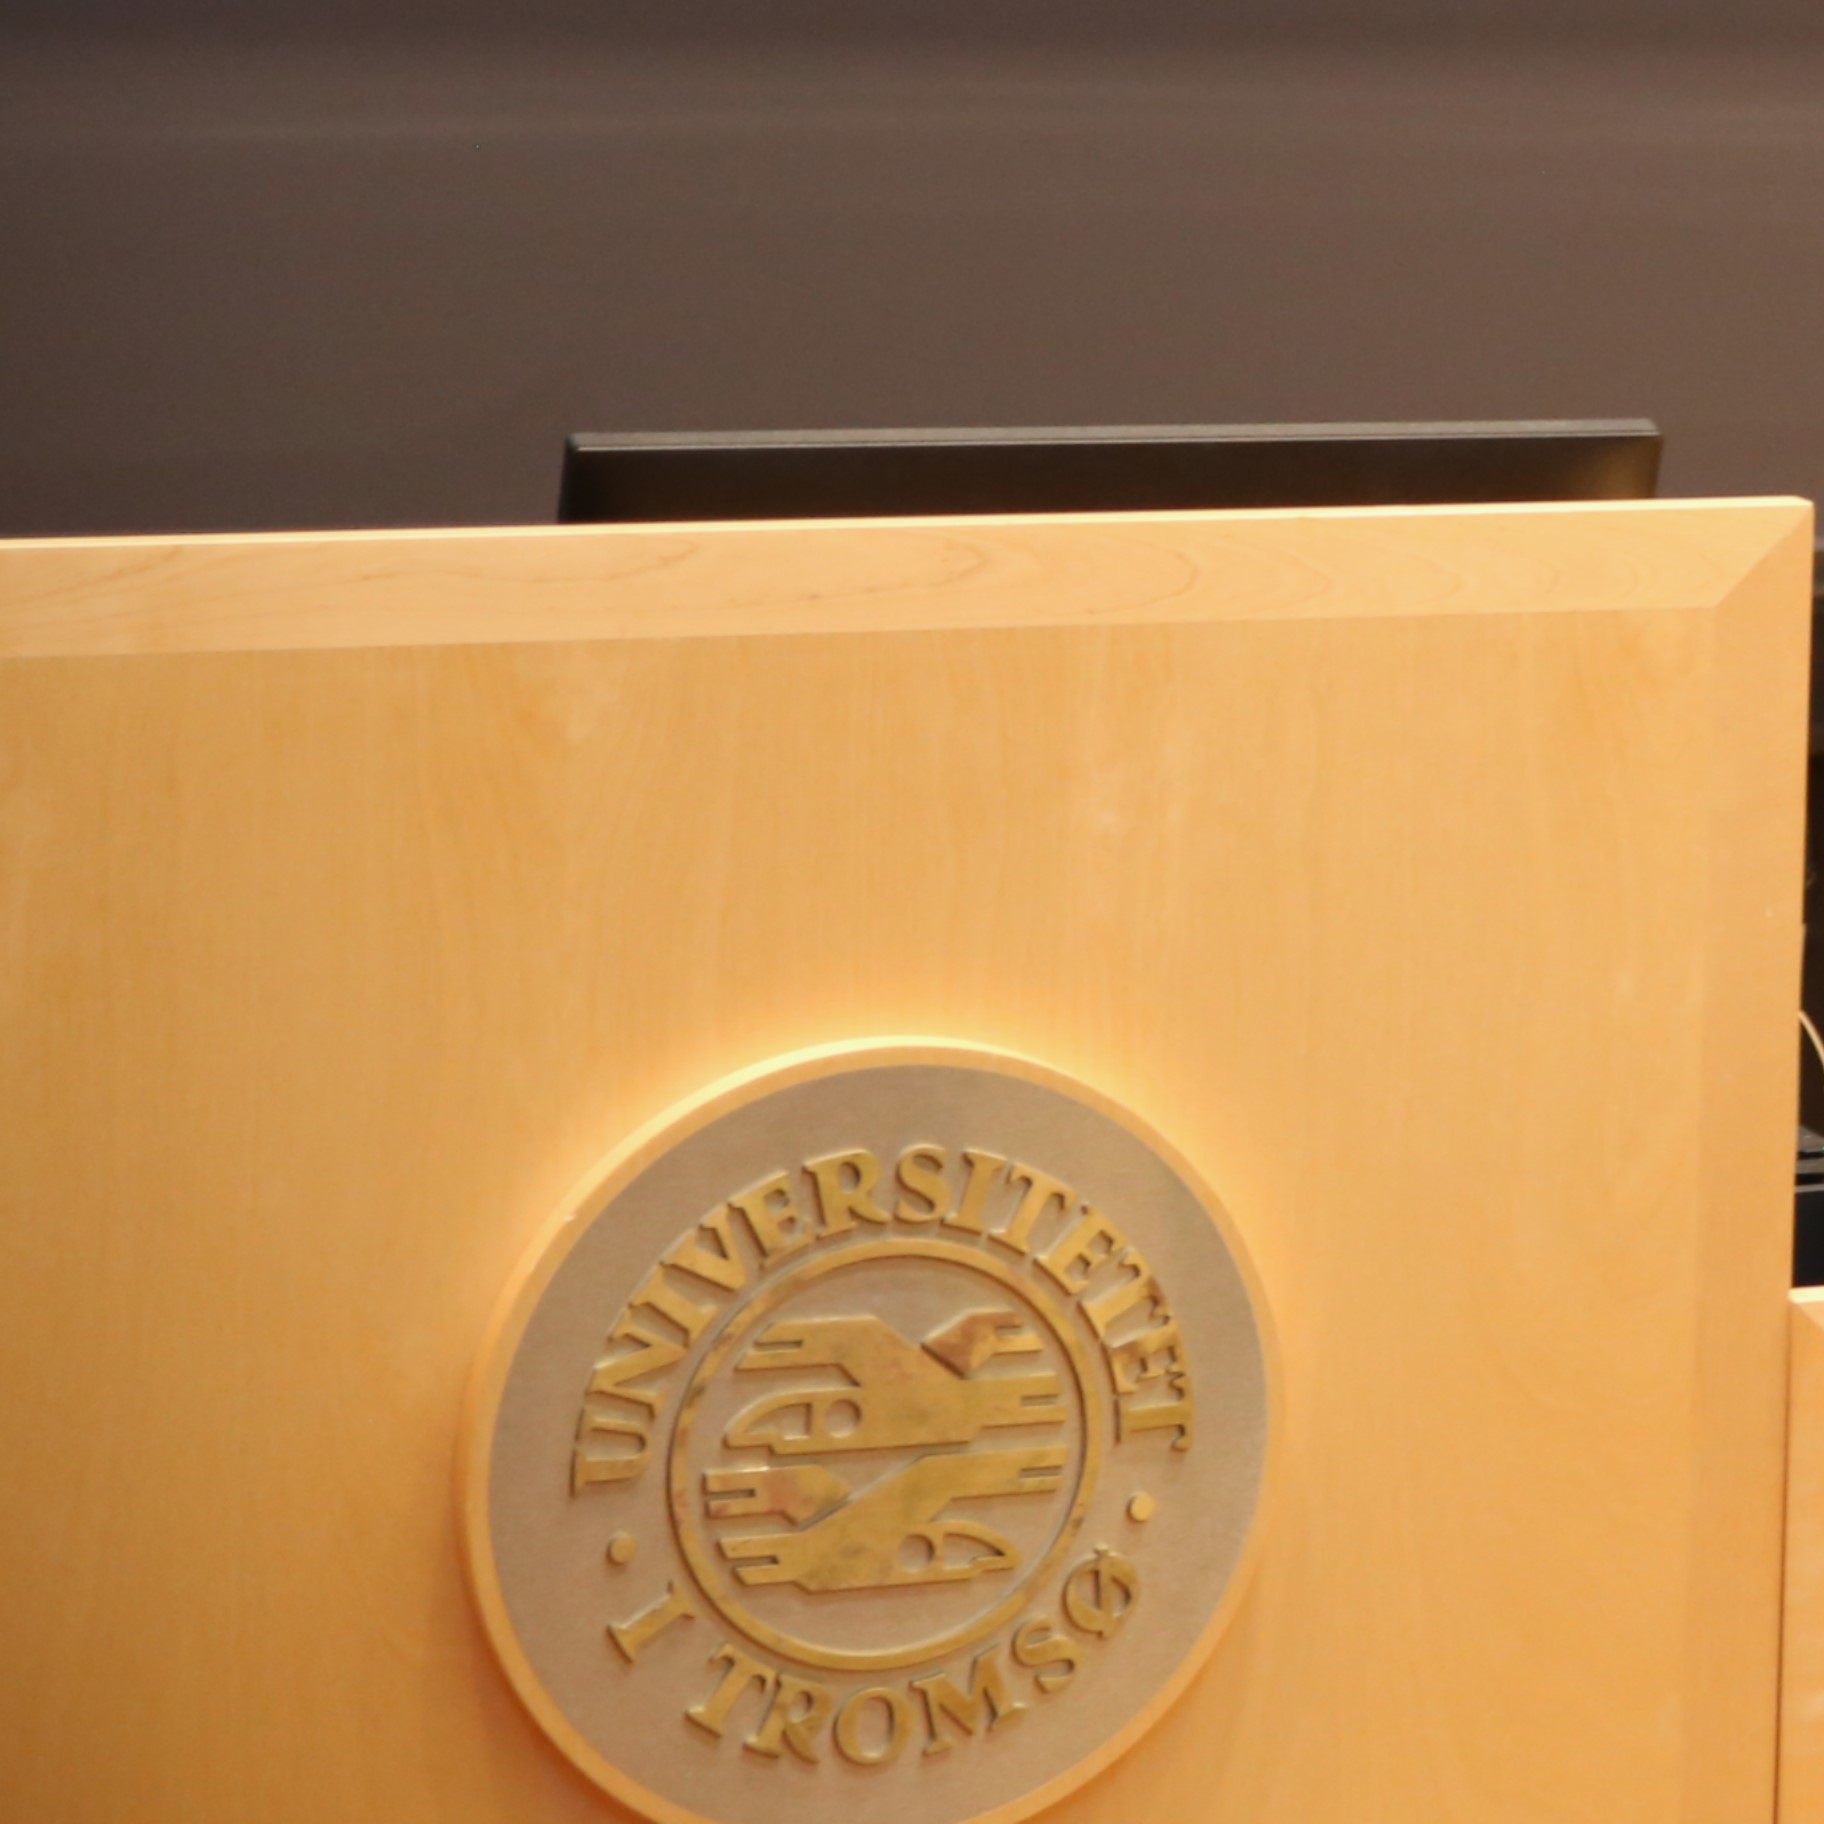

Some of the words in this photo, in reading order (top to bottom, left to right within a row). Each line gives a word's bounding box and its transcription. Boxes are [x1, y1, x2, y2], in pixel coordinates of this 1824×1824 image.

[571, 1144, 1194, 1499] UNIVERSITETET
[607, 1581, 696, 1664] I
[685, 1545, 1142, 1767] TROMSØ
